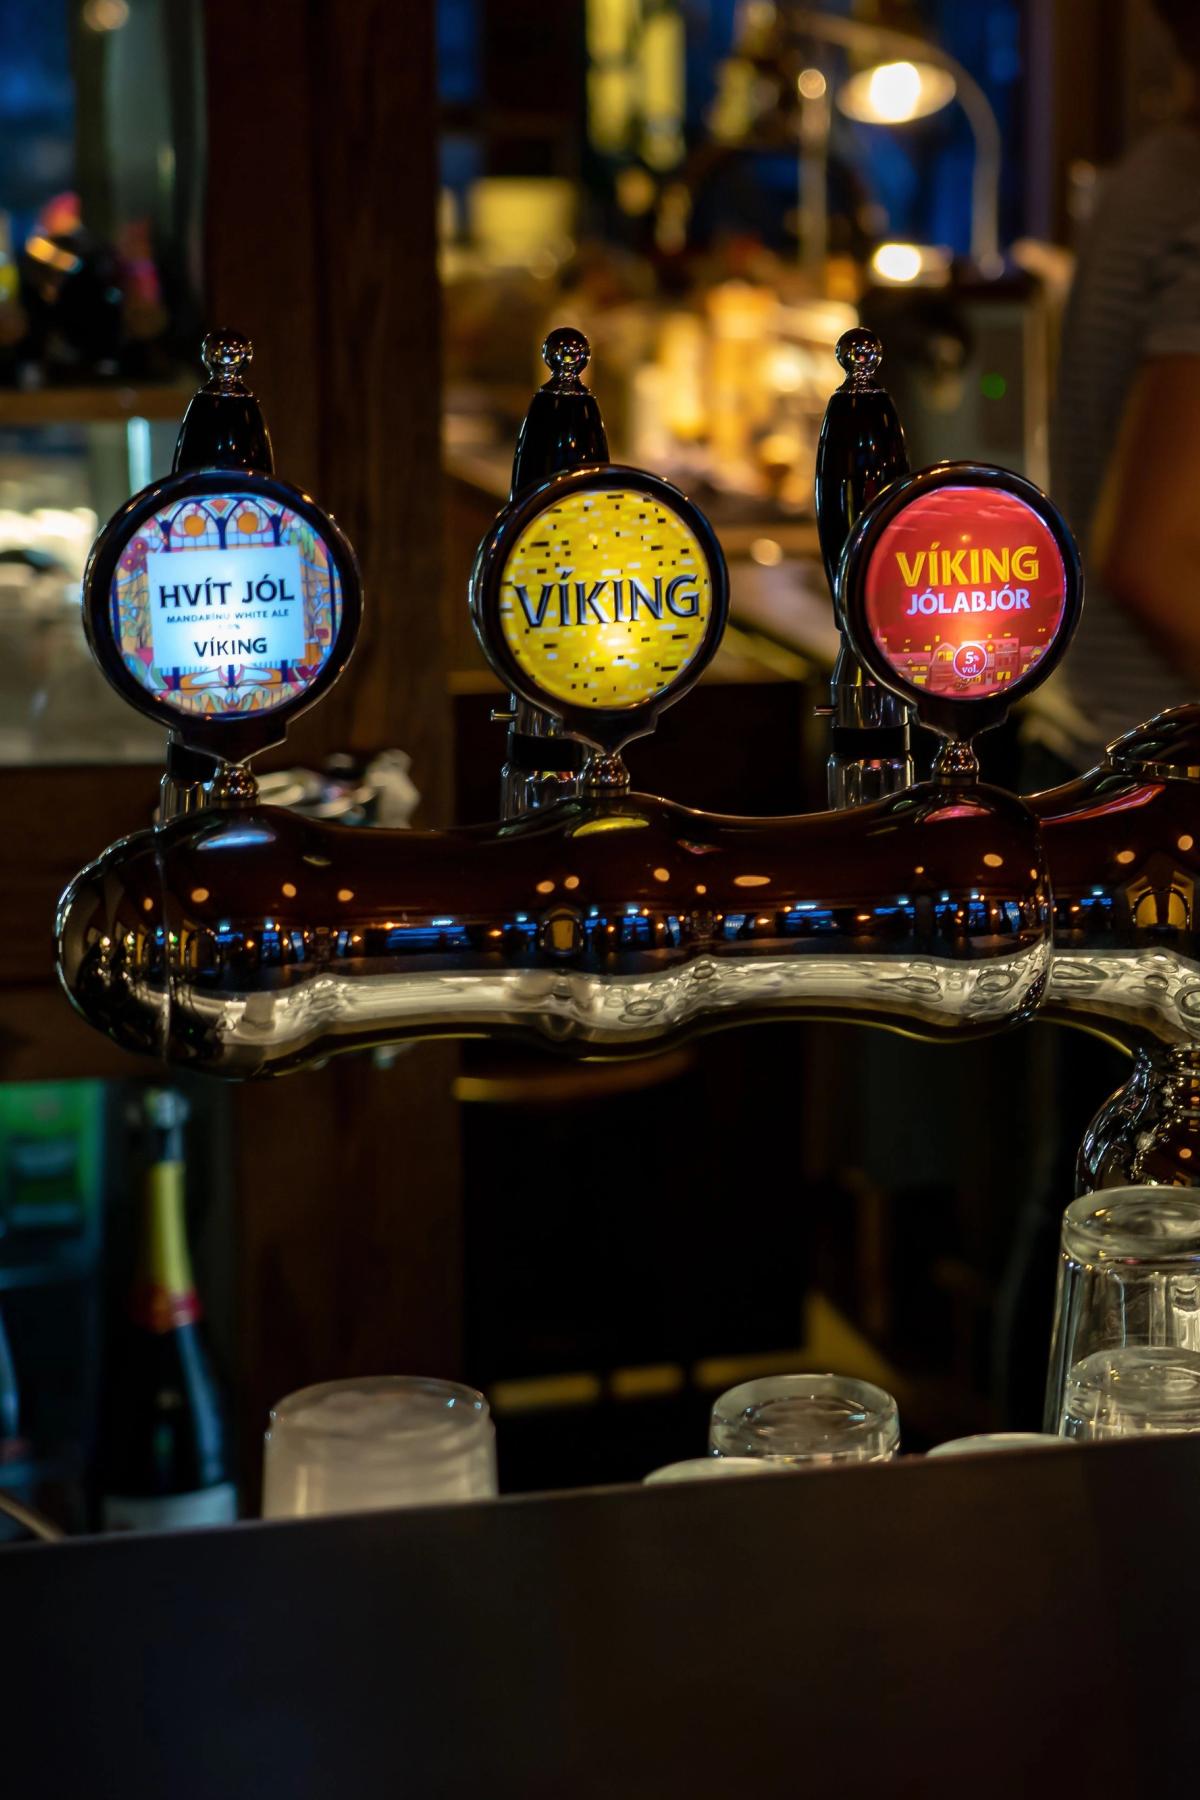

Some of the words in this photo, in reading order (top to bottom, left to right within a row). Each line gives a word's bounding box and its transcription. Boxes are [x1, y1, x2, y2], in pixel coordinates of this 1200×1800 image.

[896, 541, 1039, 587] VÍKING
[159, 577, 232, 608] HVÍT
[242, 574, 295, 603] JÓL
[514, 570, 699, 628] VÍKING
[906, 584, 1031, 616] JÓLABJÓR
[235, 610, 268, 619] WHITE
[271, 608, 290, 617] ALE
[194, 636, 268, 658] VÍKING
